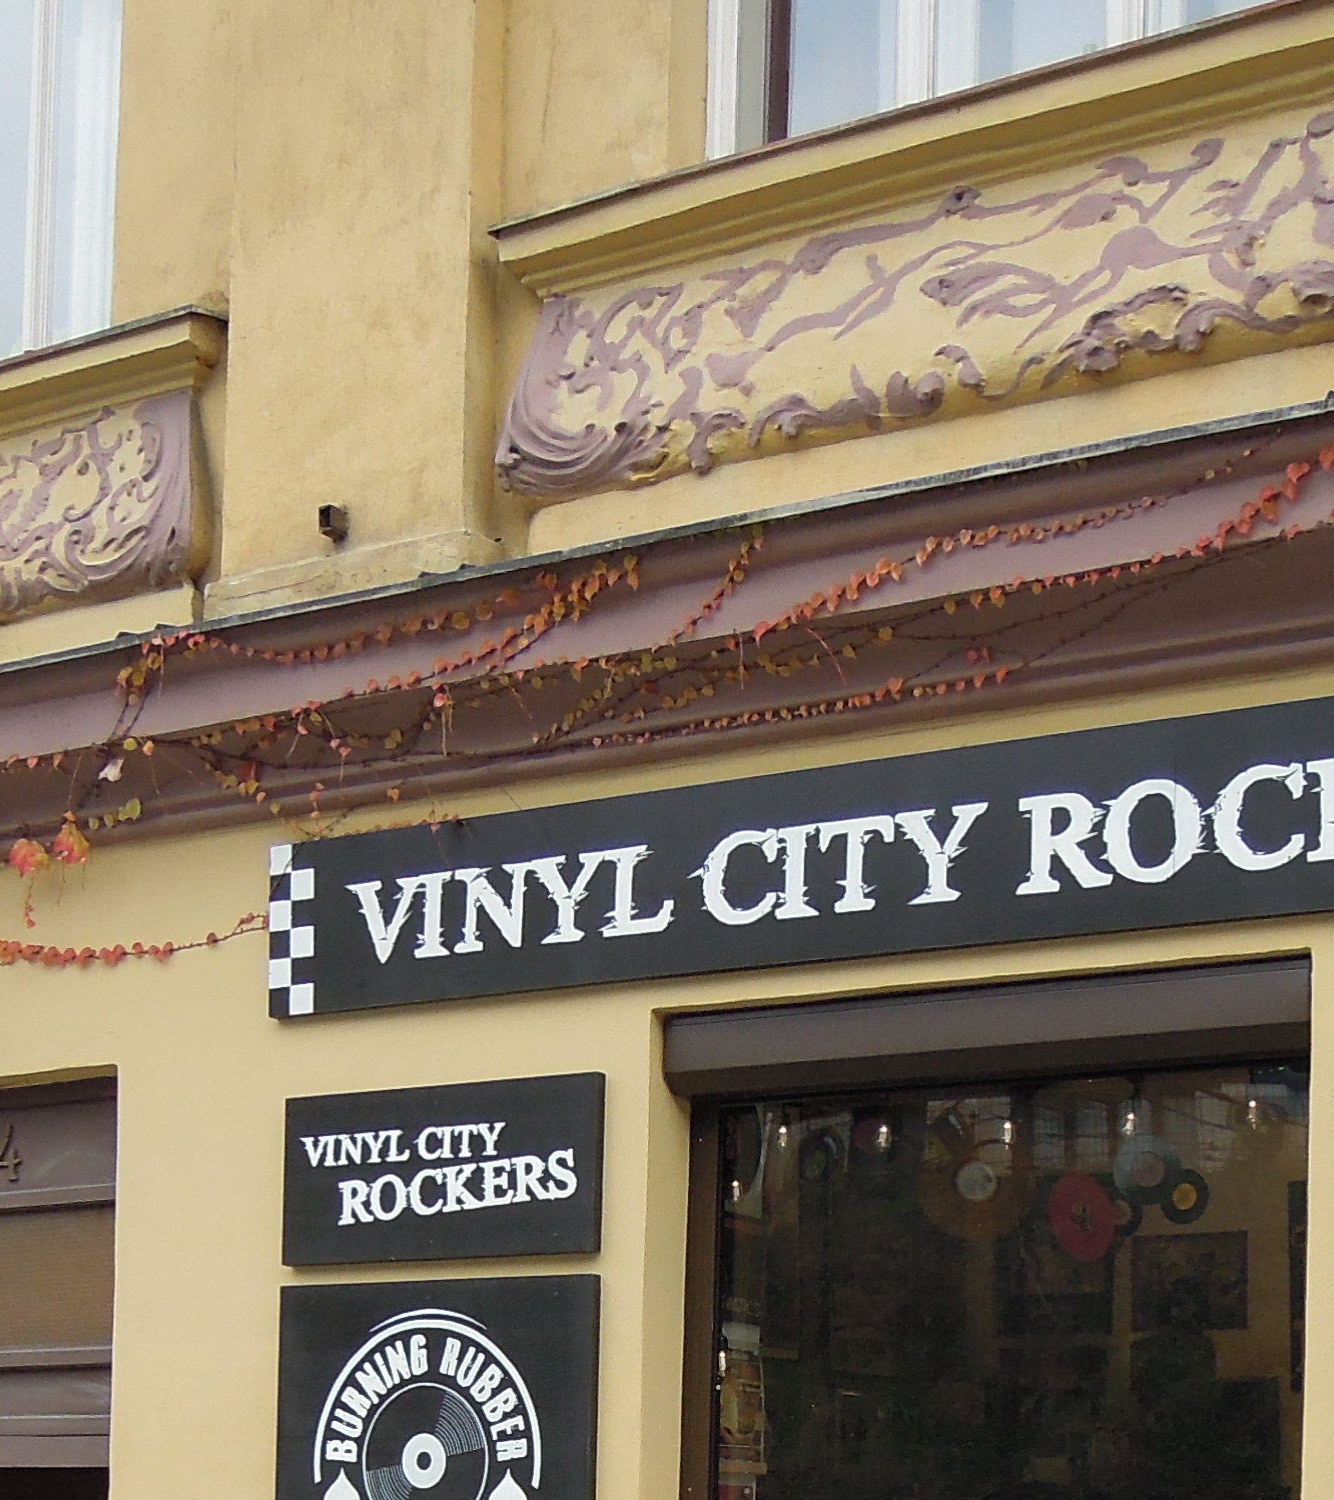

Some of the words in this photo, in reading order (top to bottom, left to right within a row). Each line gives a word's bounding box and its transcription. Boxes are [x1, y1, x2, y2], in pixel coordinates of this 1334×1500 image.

[347, 845, 674, 964] VINYL
[689, 803, 987, 925] CITY
[299, 1129, 410, 1167] VINYL
[413, 1122, 506, 1160] CITY
[337, 1149, 577, 1226] ROCKERS
[325, 1334, 428, 1462] BURNING
[439, 1337, 528, 1462] RUBBER
